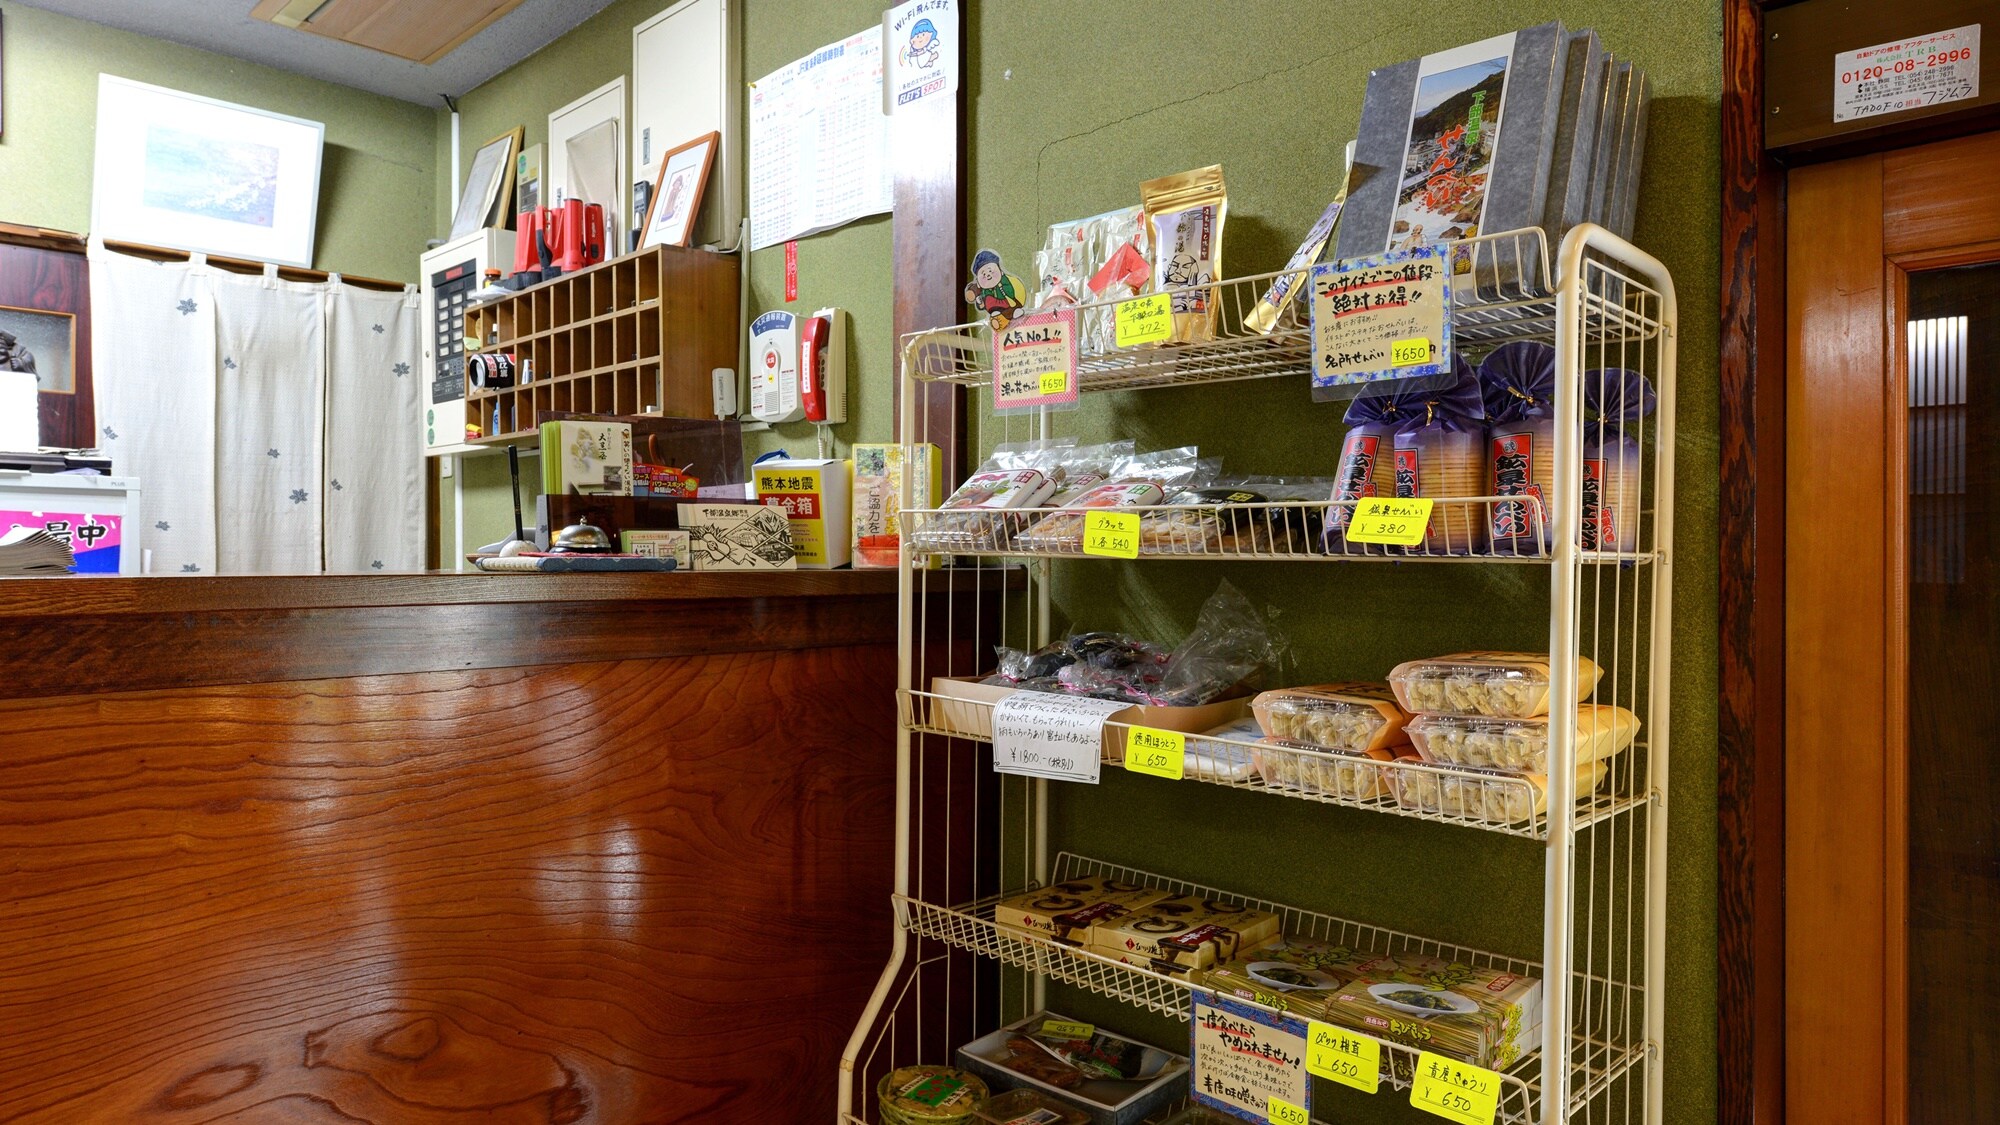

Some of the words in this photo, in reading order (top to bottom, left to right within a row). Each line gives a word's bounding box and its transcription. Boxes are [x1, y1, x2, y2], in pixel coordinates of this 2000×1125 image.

[1842, 47, 1971, 84] 0120-08-2996
[923, 79, 944, 95] SPOT
[1905, 97, 1922, 107] 担当
[1426, 124, 1465, 208] せんべい
[1325, 349, 1384, 369] 名所せんべい
[1395, 347, 1425, 361] ¥650
[1042, 378, 1064, 389] ¥650
[652, 481, 686, 489] パワースポット
[761, 476, 813, 490] 熊本地震
[765, 497, 813, 515] 募金箱
[1099, 517, 1125, 530] グラッセ
[1377, 523, 1406, 534] 380
[1098, 536, 1107, 547] 各
[1113, 538, 1129, 549] 540
[1134, 733, 1176, 750] 徳用ほうとう
[1147, 754, 1168, 766] 650
[1197, 1009, 1256, 1037] 一度食べたら
[1219, 1032, 1300, 1069] やめられません!
[1332, 1060, 1358, 1077] 650
[1429, 1061, 1486, 1092] 青唐きゅうり
[1442, 1092, 1471, 1111] 650
[1281, 1107, 1304, 1124] 650
